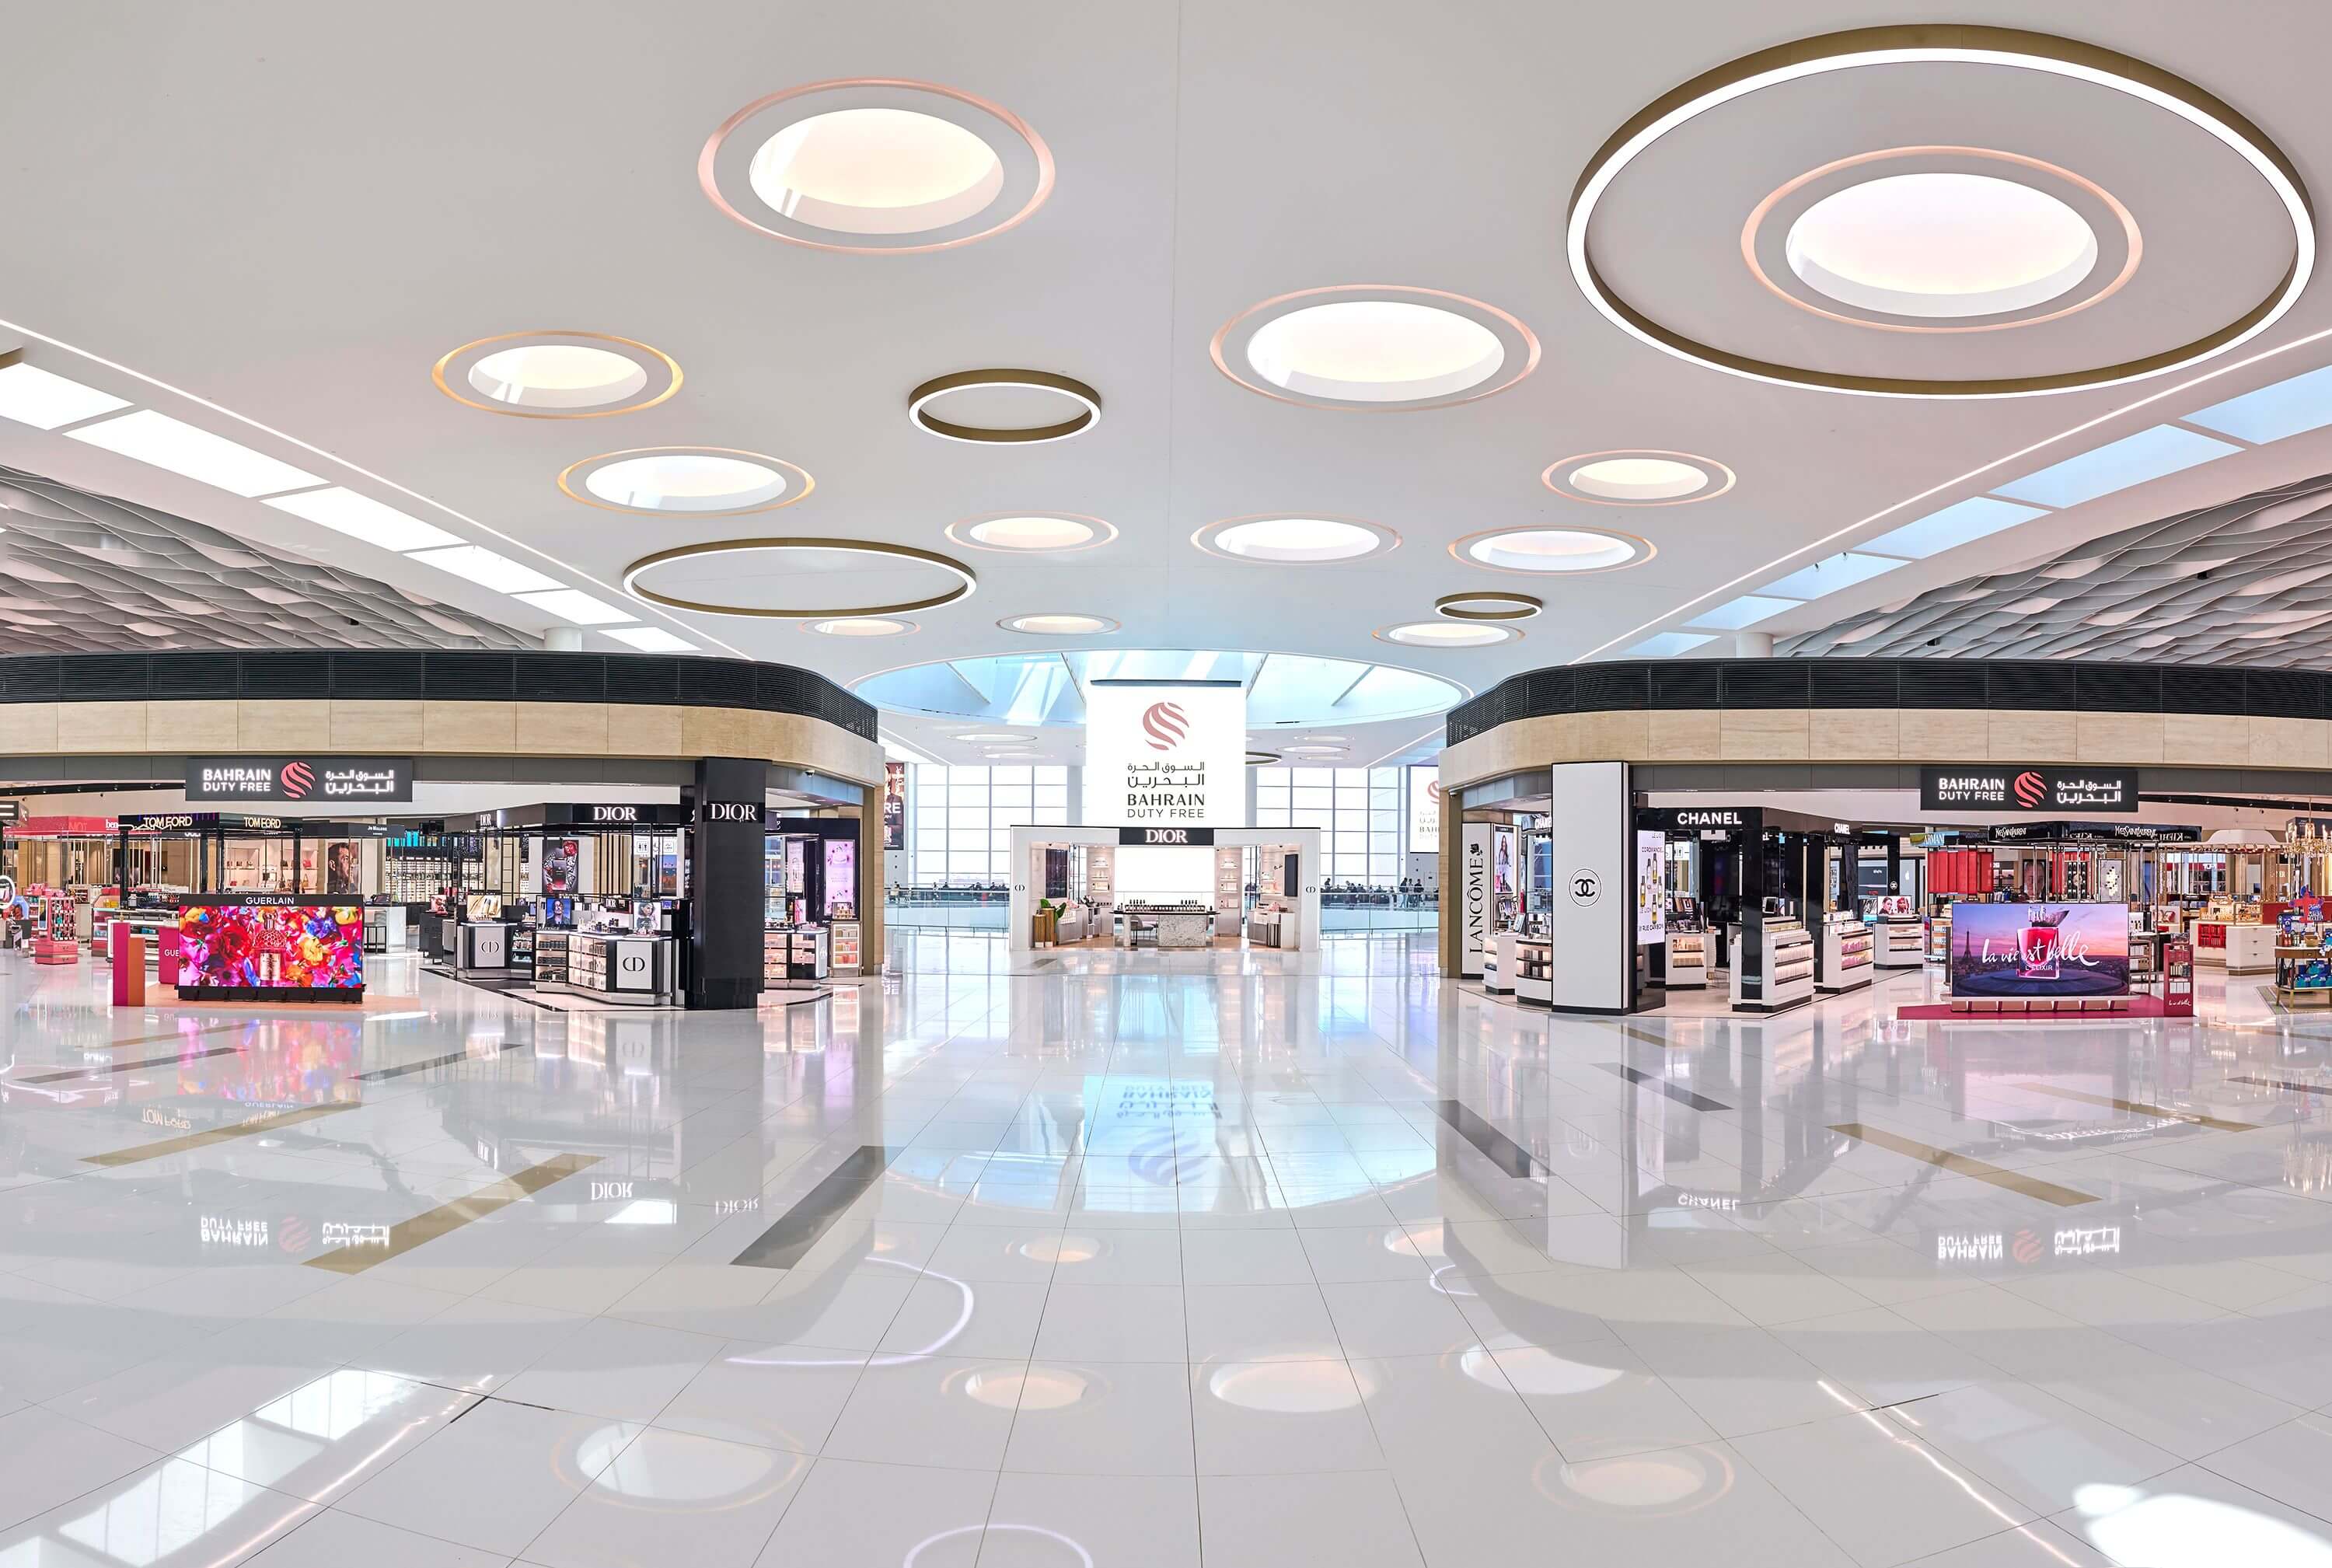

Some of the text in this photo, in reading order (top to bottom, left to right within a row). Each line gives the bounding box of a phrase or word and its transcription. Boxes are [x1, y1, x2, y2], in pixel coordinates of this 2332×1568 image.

[1127, 761, 1205, 773] السوق الحرة
[203, 769, 271, 781] BAHRAIN
[325, 769, 394, 781] السوق الحرة
[1127, 774, 1205, 788] البحرين
[203, 782, 271, 792] DUTY FREE
[325, 781, 394, 794] البحرين
[1939, 778, 2005, 790] BAHRAIN
[2057, 780, 2121, 790] السوق الحرة
[1127, 794, 1204, 805] BAHRAIN
[1939, 791, 2005, 800] DUTY FREE
[2057, 791, 2121, 804] البحرين
[593, 806, 637, 821] DIOR
[710, 803, 757, 821] DIOR
[884, 801, 901, 814] RE
[1127, 808, 1204, 818] DUTY FREE
[106, 819, 118, 829] ben
[143, 816, 193, 827] TOM FORD
[243, 816, 281, 829] TOM FORD
[1677, 812, 1743, 825] CHANEL
[1835, 822, 1851, 835] CHANEL
[1145, 829, 1188, 843] DIOR
[245, 896, 295, 905] GUERLAIN
[1467, 857, 1483, 953] LANCÔME
[2001, 947, 2020, 963] vie
[2047, 931, 2100, 966] belle
